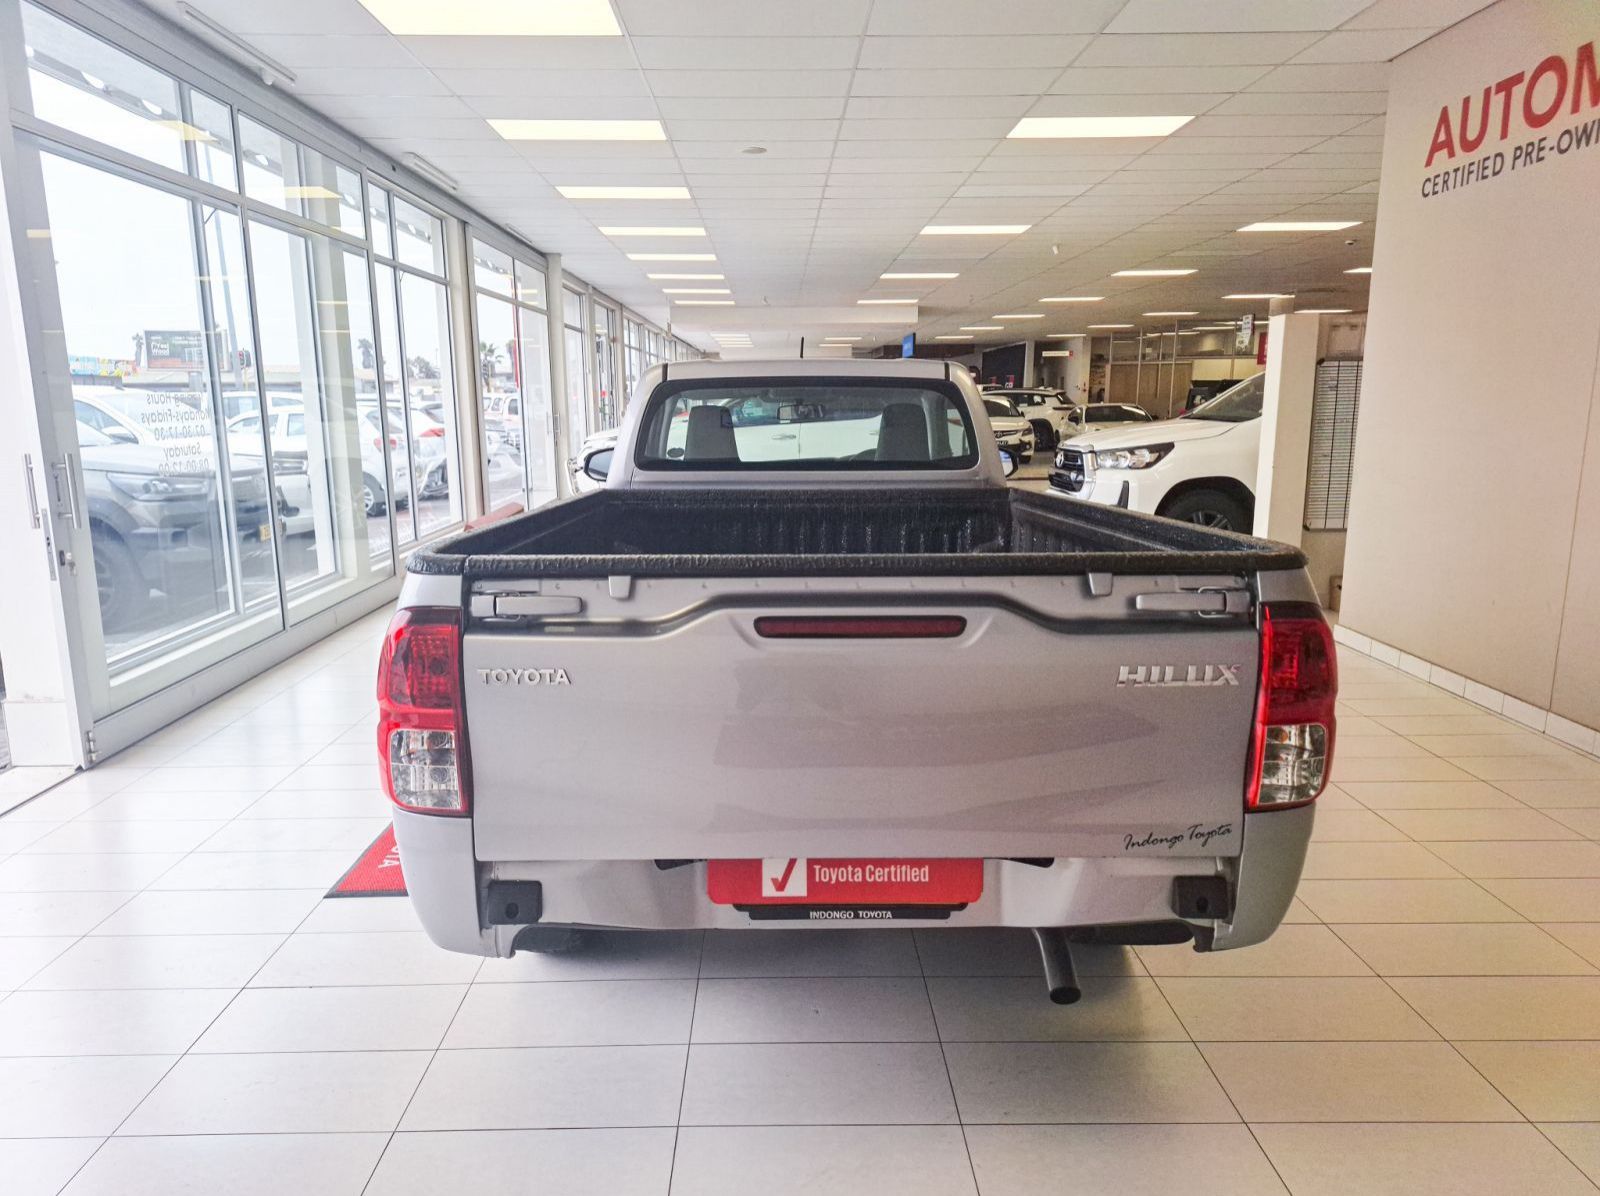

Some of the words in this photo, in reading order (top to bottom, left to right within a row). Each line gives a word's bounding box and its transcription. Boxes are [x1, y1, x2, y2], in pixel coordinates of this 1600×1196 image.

[1421, 152, 1505, 198] CERTIFIED
[478, 668, 571, 686] TOYOTA
[1116, 664, 1241, 687] HILUX
[1123, 831, 1184, 851] Indongo
[1187, 823, 1233, 848] Toyota
[813, 864, 862, 885] Toyota
[865, 864, 929, 883] Certified
[809, 910, 854, 920] INDONGO
[858, 910, 893, 920] TOYOTA
